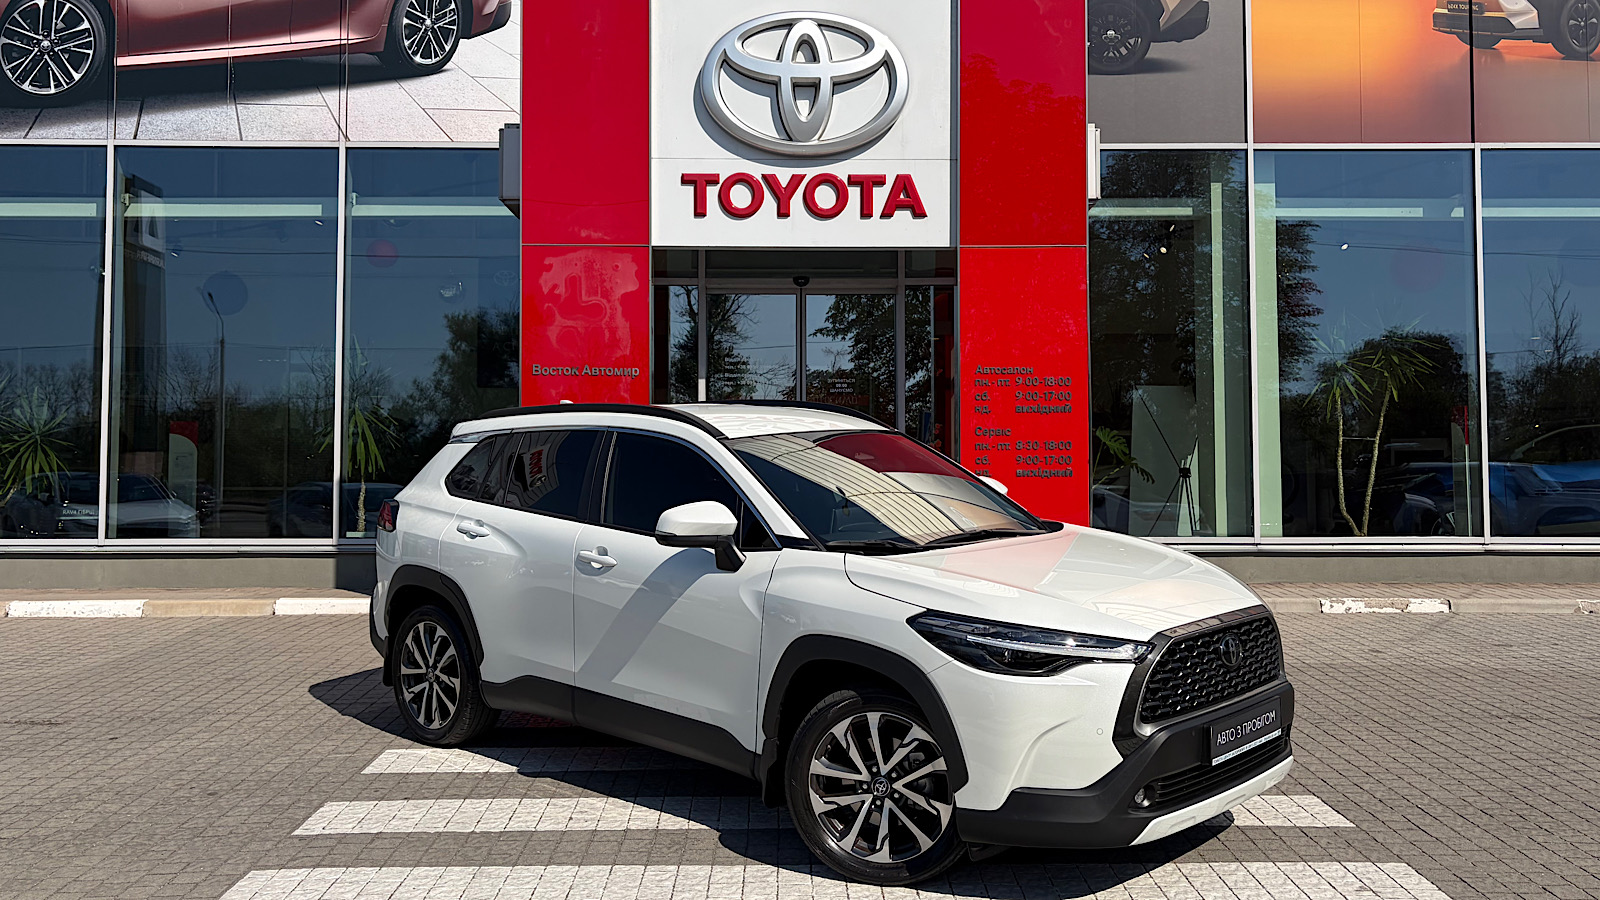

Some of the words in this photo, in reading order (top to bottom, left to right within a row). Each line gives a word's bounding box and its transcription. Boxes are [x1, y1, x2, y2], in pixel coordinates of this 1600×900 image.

[681, 172, 928, 221] TOYOTA
[532, 364, 579, 376] Восток
[582, 364, 640, 379] Автомир
[975, 365, 1034, 375] Автосалон
[1015, 377, 1072, 387] 9:00-18:00
[975, 391, 991, 401] сб.
[1015, 391, 1072, 401] 9:00-17:00
[975, 405, 991, 414] нд.
[1015, 402, 1072, 414] вихідний
[975, 426, 1012, 438] Сервіс
[975, 455, 991, 465] сб.
[1015, 455, 1073, 465] 9:00-17:00
[1016, 467, 1073, 478] вихідний
[1216, 728, 1235, 746] АВТО
[1242, 710, 1276, 735] ПРОБІГОМ
